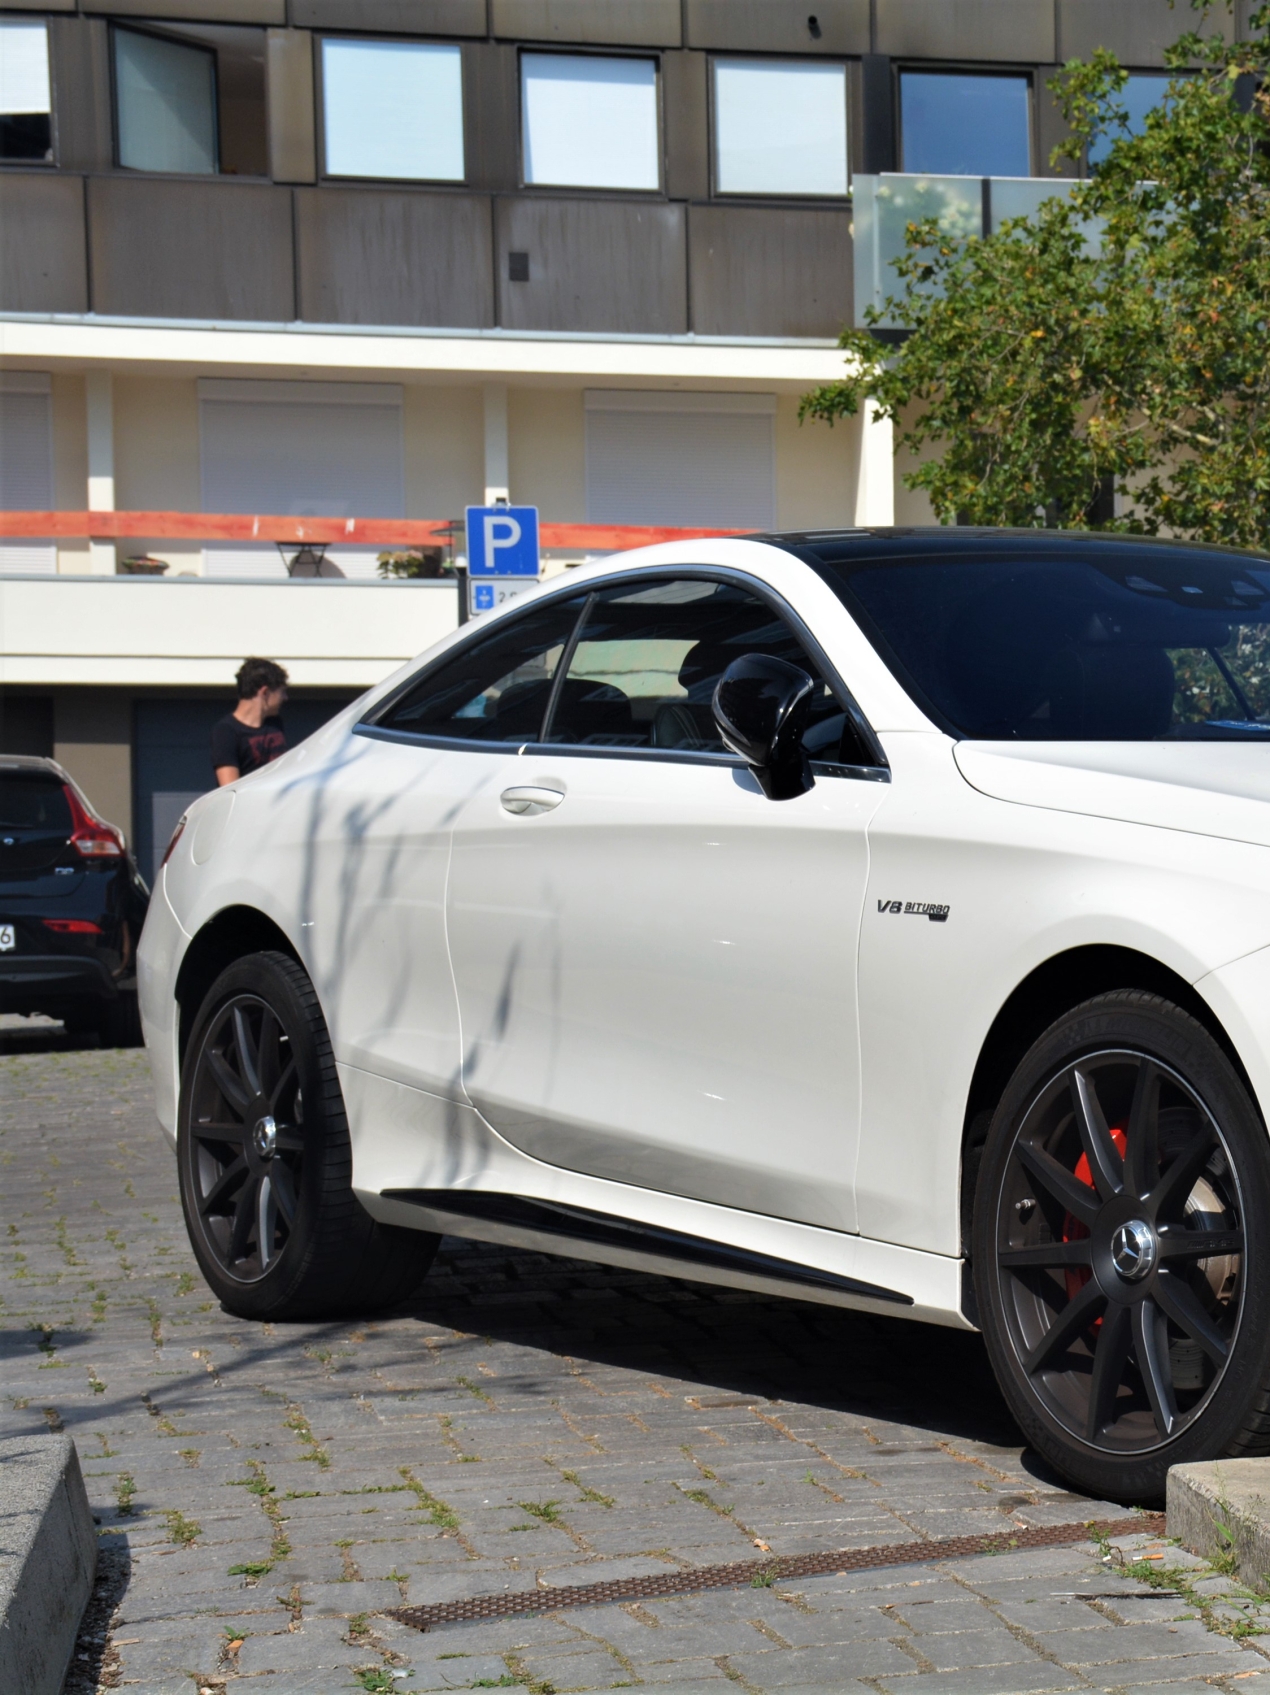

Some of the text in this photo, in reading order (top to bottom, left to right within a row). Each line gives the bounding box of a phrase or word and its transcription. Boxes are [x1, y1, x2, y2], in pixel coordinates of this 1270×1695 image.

[484, 515, 522, 568] P
[877, 899, 951, 915] V8 BITURBO
